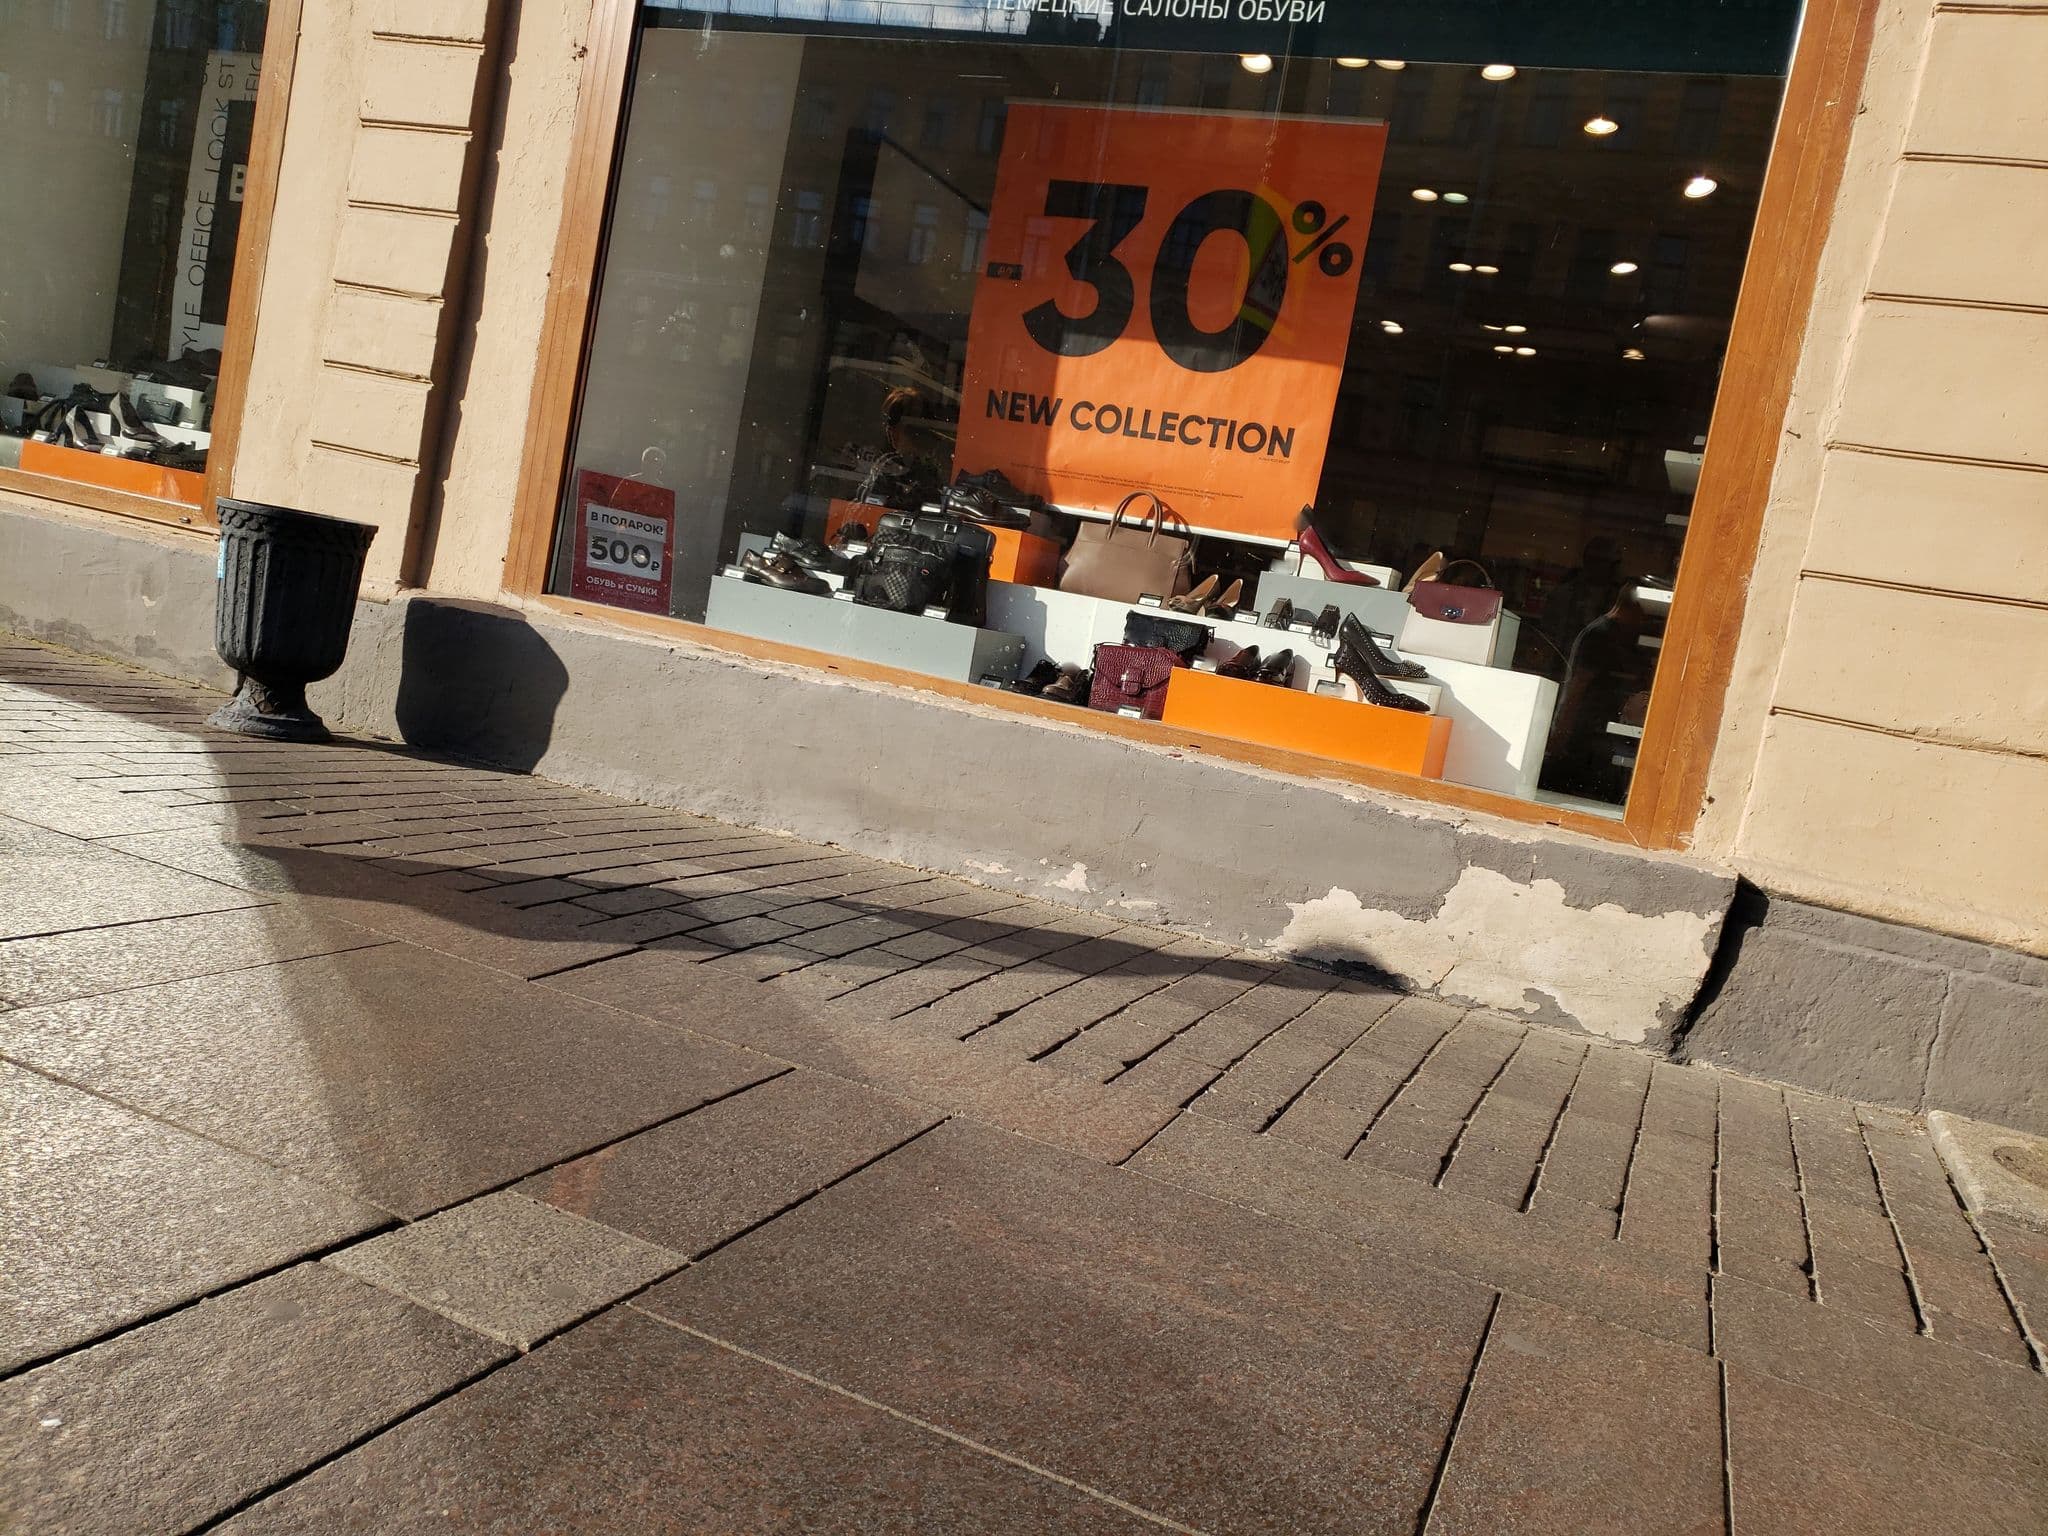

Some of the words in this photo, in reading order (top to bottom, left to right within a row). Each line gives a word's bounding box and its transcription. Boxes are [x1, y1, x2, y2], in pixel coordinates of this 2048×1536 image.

[1123, 0, 1230, 19] САЛОНЫ
[1238, 0, 1326, 23] ОБУВИ
[188, 190, 217, 287] OFFICE
[182, 302, 201, 350] YLE
[986, 388, 1063, 427] NEW
[1070, 400, 1296, 459] COLLECTION
[590, 511, 599, 521] В
[601, 513, 664, 536] ПОДАРОК!
[586, 575, 617, 589] ОБУВЬ
[625, 583, 659, 597] СУМКИ
